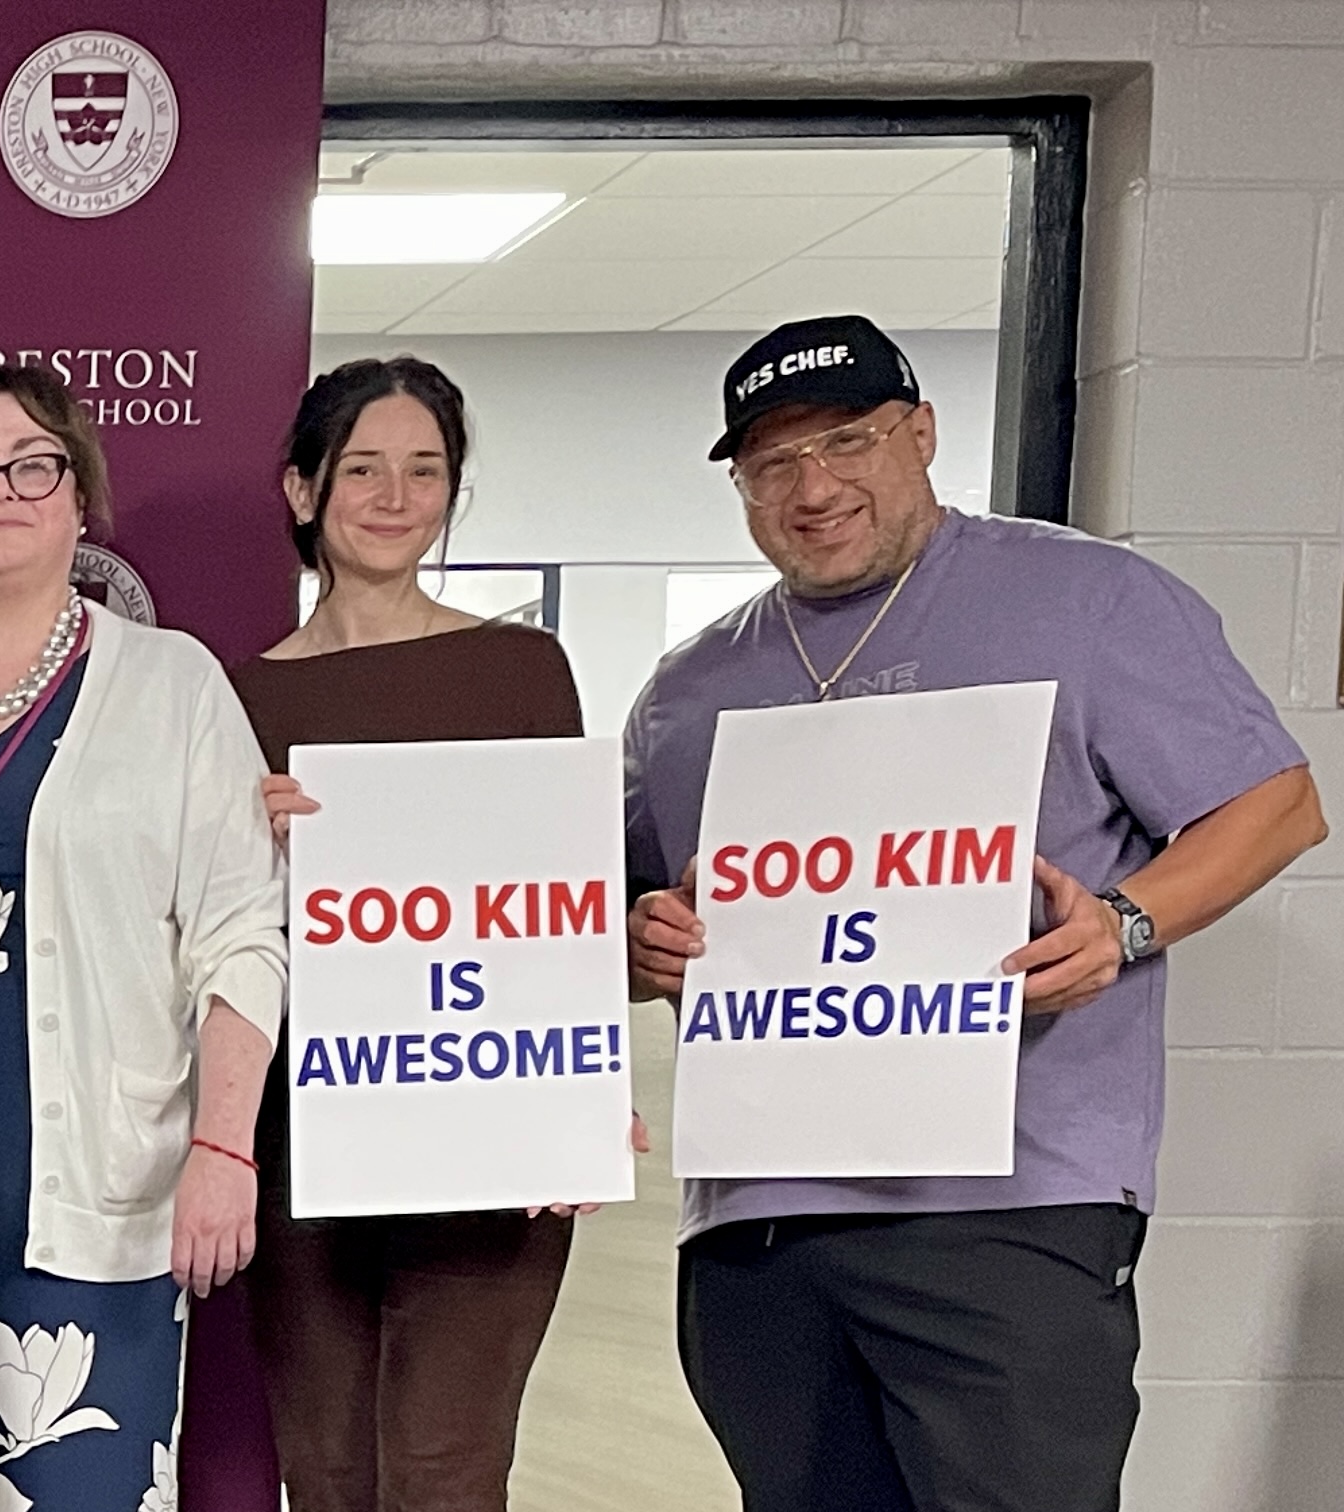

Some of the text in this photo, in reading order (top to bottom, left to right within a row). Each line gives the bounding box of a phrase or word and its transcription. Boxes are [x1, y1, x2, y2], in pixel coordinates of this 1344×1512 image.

[735, 345, 855, 403] YES CHEF.
[711, 825, 1016, 902] SOO KIM
[305, 880, 606, 945] SOO KIM
[821, 911, 876, 964] IS
[430, 961, 484, 1011] IS
[685, 981, 1013, 1042] AWESOME!
[297, 1024, 619, 1087] AWESOME!
